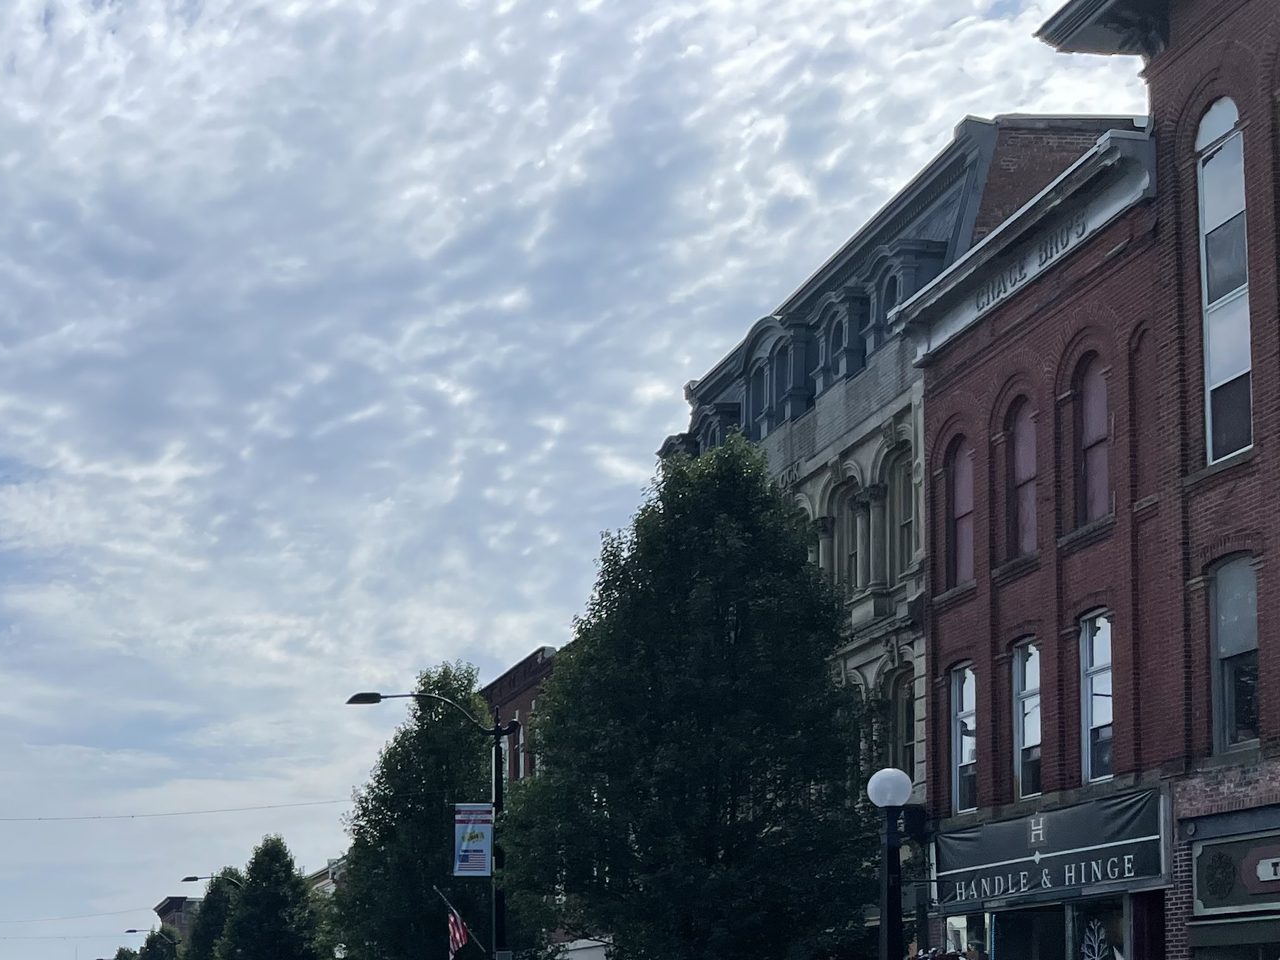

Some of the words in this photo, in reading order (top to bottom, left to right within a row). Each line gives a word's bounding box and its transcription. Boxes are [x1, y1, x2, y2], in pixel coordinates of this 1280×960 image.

[956, 871, 1029, 900] HANDLE
[1041, 869, 1052, 889] &
[1064, 854, 1135, 886] HINGE
